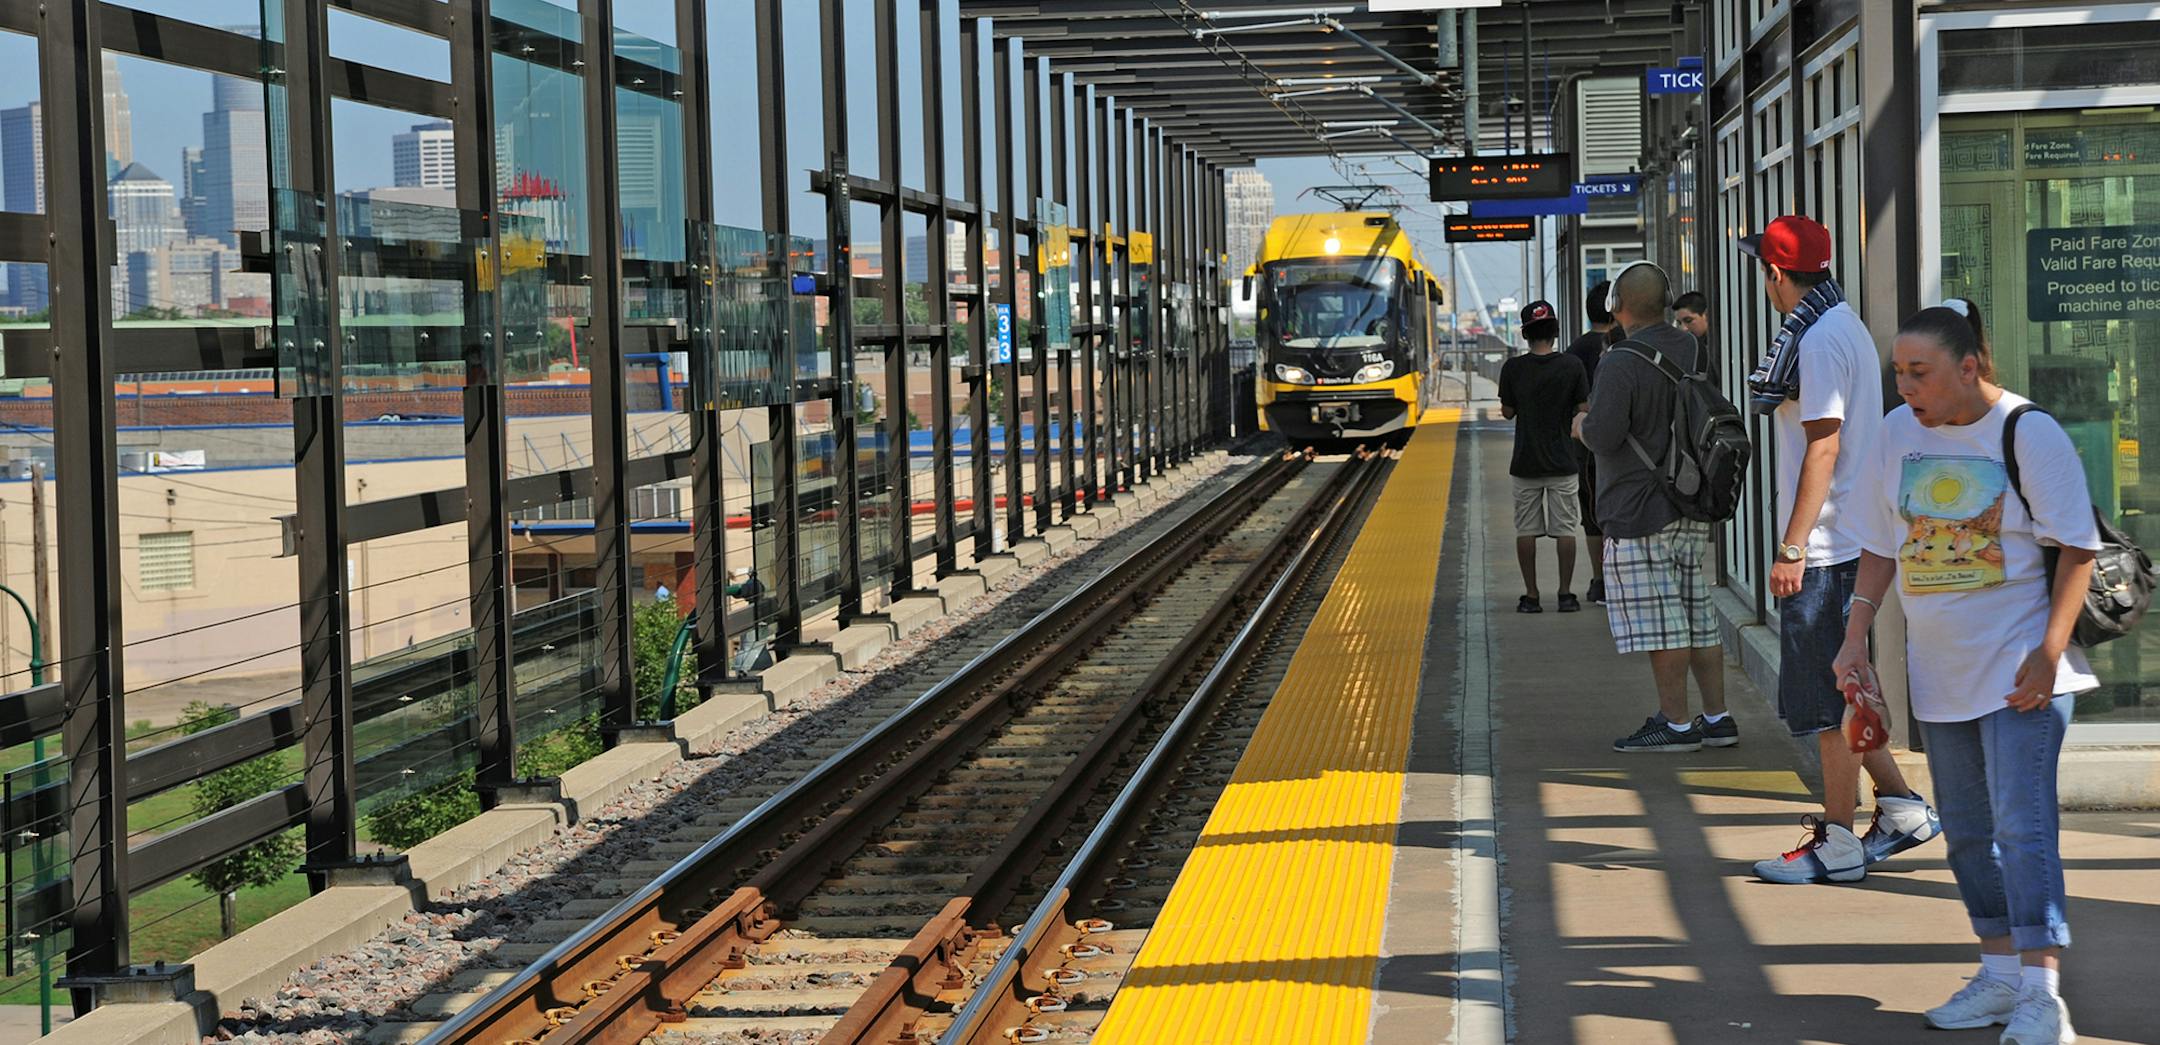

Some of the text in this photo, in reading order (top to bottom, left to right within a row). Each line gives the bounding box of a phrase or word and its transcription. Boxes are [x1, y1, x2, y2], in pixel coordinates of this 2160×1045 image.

[1660, 73, 1704, 88] TICK
[1575, 184, 1617, 194] TICKETS
[2050, 237, 2086, 251] Paid
[2091, 236, 2127, 250] Fare
[2040, 254, 2160, 271] Valid Fare Requ
[2048, 280, 2115, 295] Proceed
[2120, 280, 2136, 293] to
[2059, 299, 2122, 313] machine
